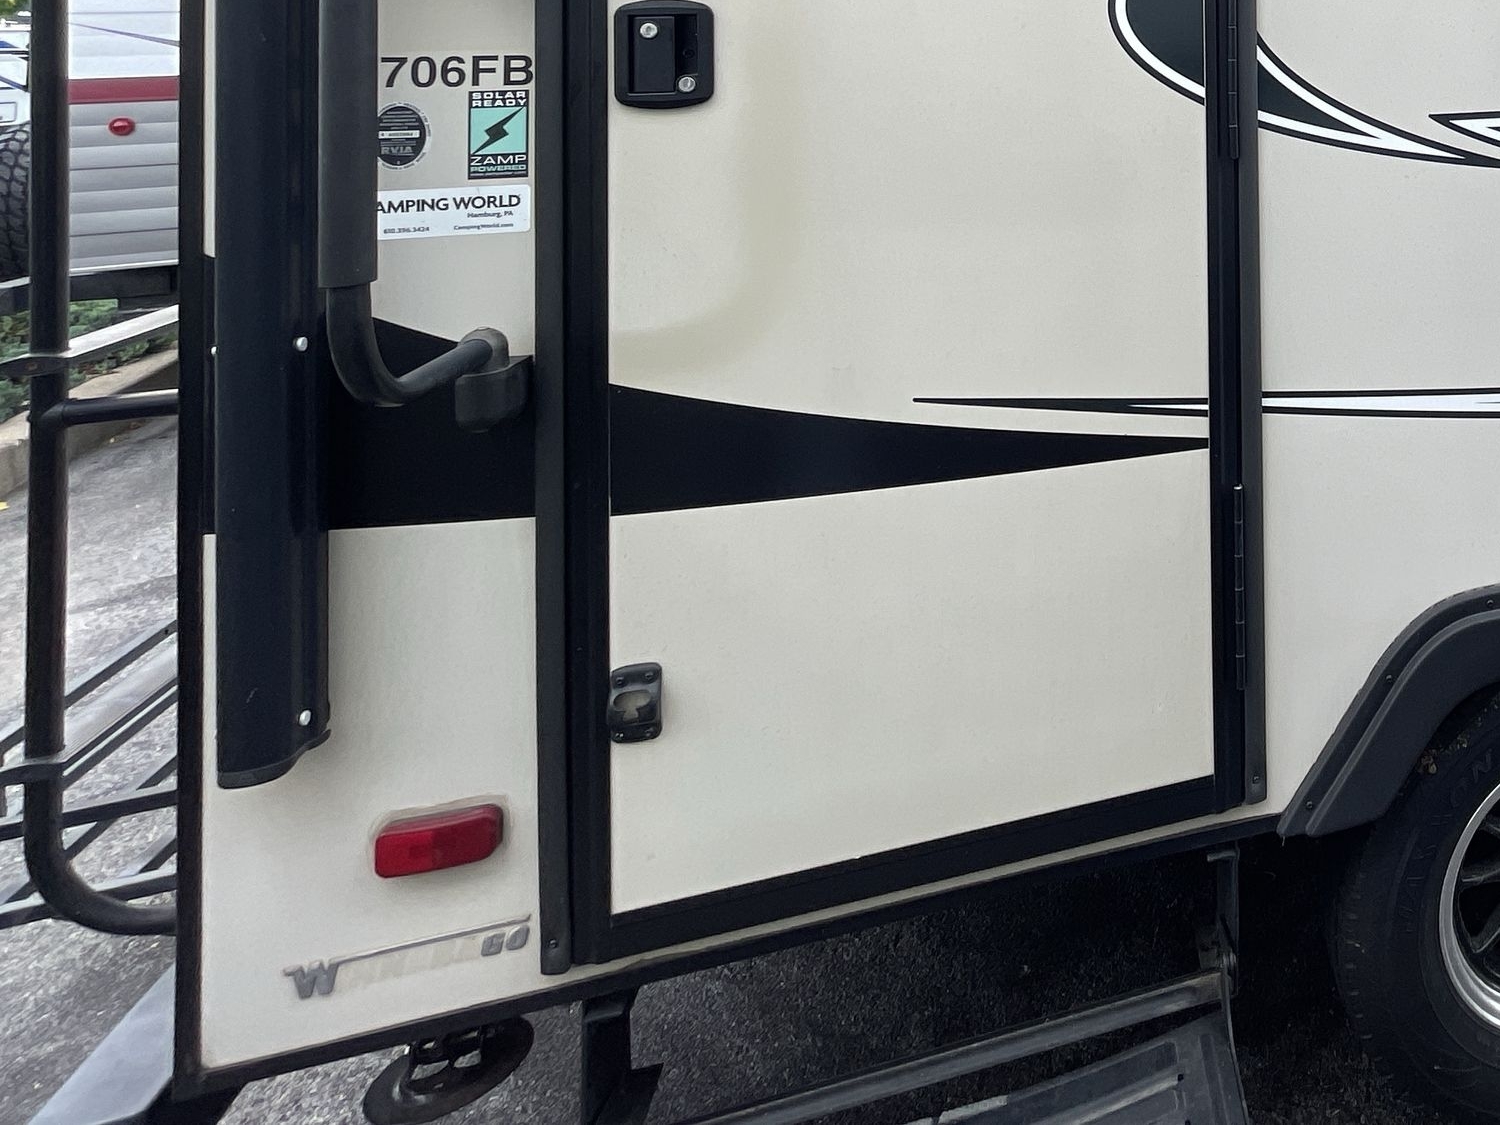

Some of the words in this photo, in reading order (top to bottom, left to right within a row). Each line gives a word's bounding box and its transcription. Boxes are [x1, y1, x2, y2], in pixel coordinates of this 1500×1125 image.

[471, 91, 526, 100] SOLAR
[471, 99, 527, 107] READY
[470, 154, 527, 166] ZAMP
[470, 164, 527, 173] POWERED
[377, 197, 449, 215] AMPING
[453, 194, 521, 211] WORLD
